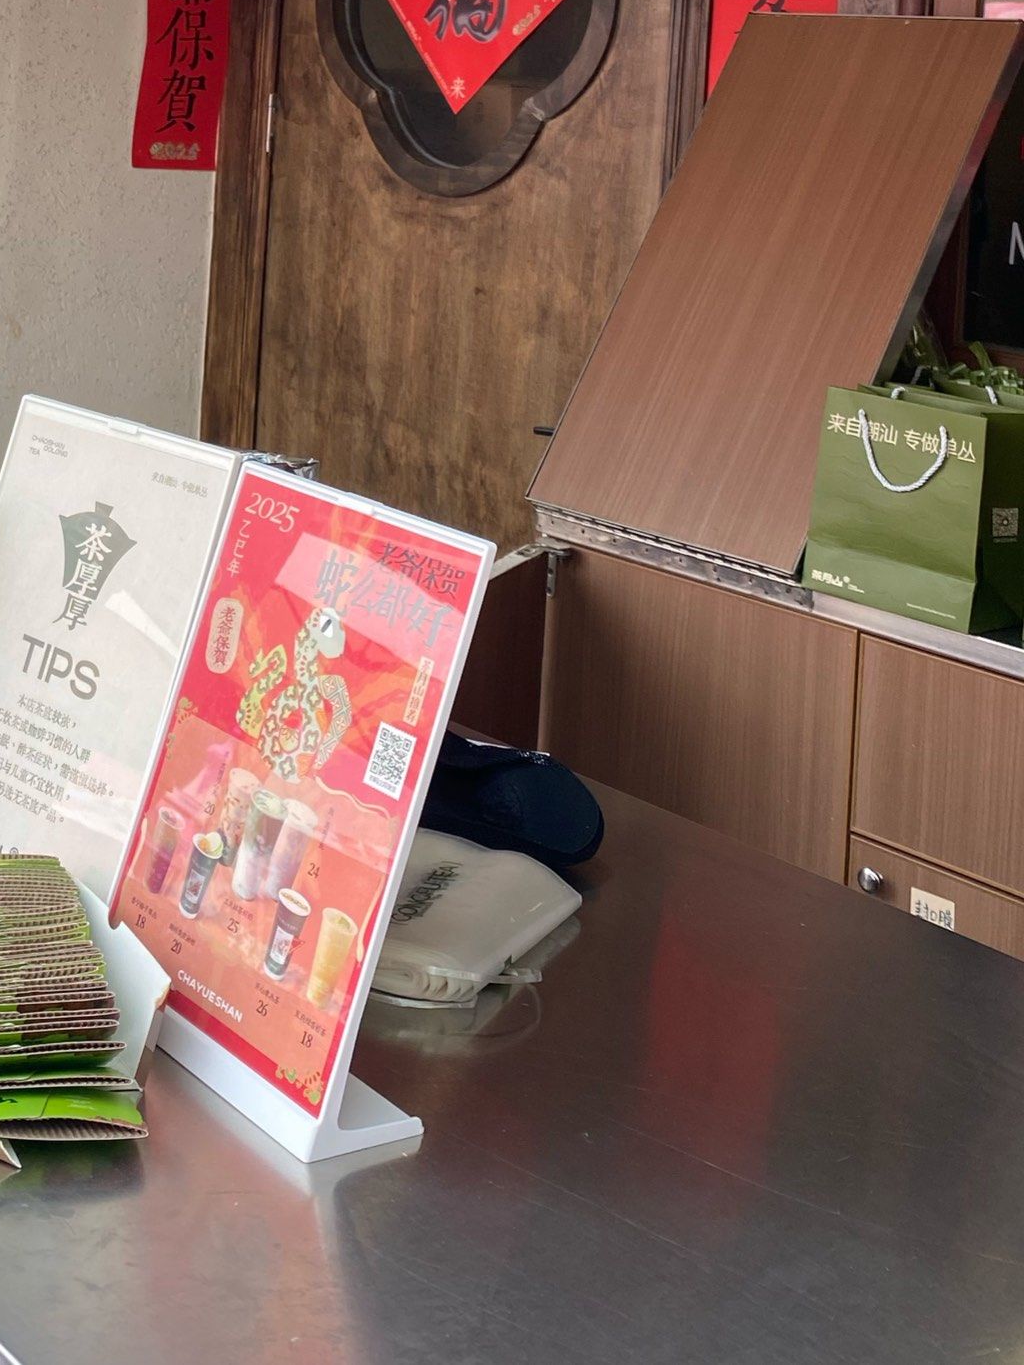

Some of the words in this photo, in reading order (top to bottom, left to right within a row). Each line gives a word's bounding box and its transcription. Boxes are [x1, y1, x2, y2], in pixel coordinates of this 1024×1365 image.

[450, 76, 466, 99] 来
[243, 492, 301, 534] 2025
[226, 518, 251, 578] 乙巳年
[52, 522, 113, 631] 茶厚厚
[22, 633, 101, 701] TIPS
[307, 862, 321, 879] 24
[135, 914, 147, 930] 18
[226, 917, 240, 934] 25
[170, 938, 183, 955] 20
[177, 969, 244, 1023] CHAYUESHAN
[256, 999, 269, 1017] 26
[300, 1030, 314, 1048] 18
